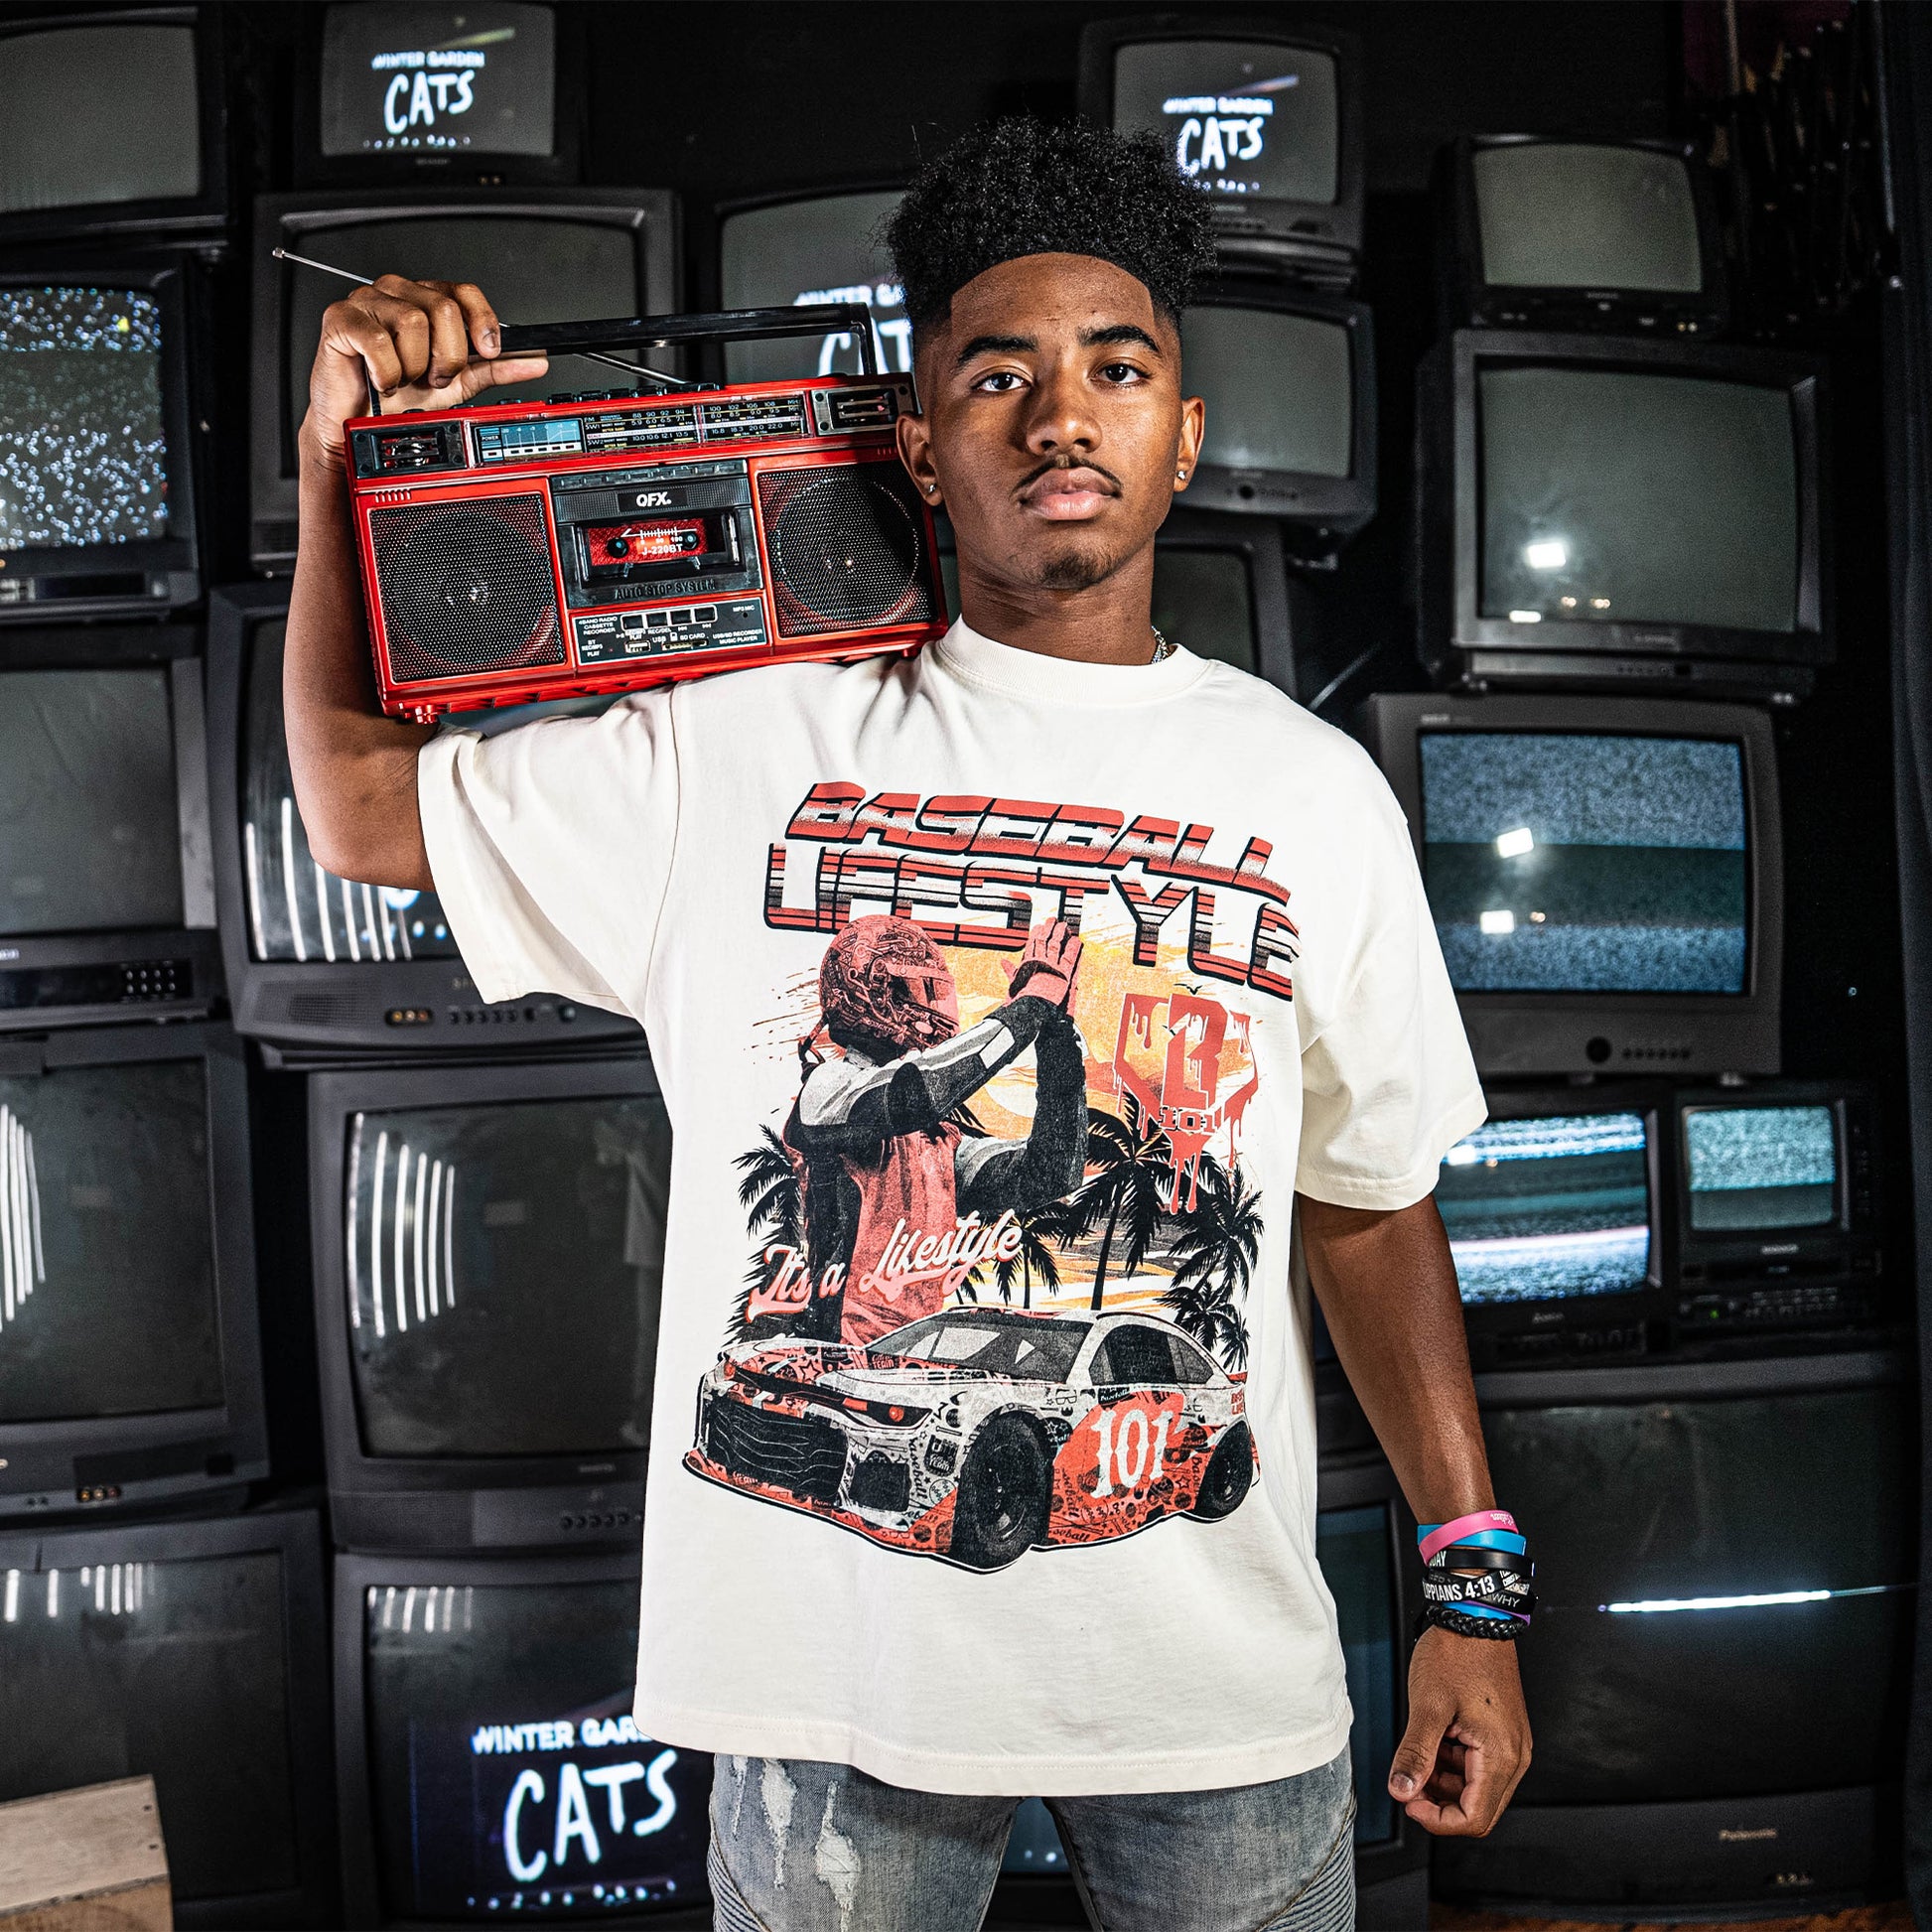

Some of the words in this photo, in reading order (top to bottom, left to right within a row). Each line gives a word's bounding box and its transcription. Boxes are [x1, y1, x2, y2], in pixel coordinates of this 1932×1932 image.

[383, 69, 476, 135] CATS
[1175, 116, 1265, 178] CATS
[641, 543, 683, 555] J-220BT
[615, 586, 643, 600] AUTO
[645, 583, 672, 596] STOP
[675, 579, 715, 593] SYSTEM
[584, 621, 614, 630] CASSETTE
[784, 780, 1291, 905] BASEBALL
[762, 842, 1301, 1003] LIFESTYLE
[818, 1262, 846, 1299] a
[859, 1207, 1024, 1305] Lifestyle
[1089, 1408, 1174, 1499] 101
[1464, 1575, 1496, 1599] 4:13
[1491, 1592, 1520, 1607] WHY
[472, 1720, 575, 1754] WINTER
[502, 1748, 678, 1882] CATS
